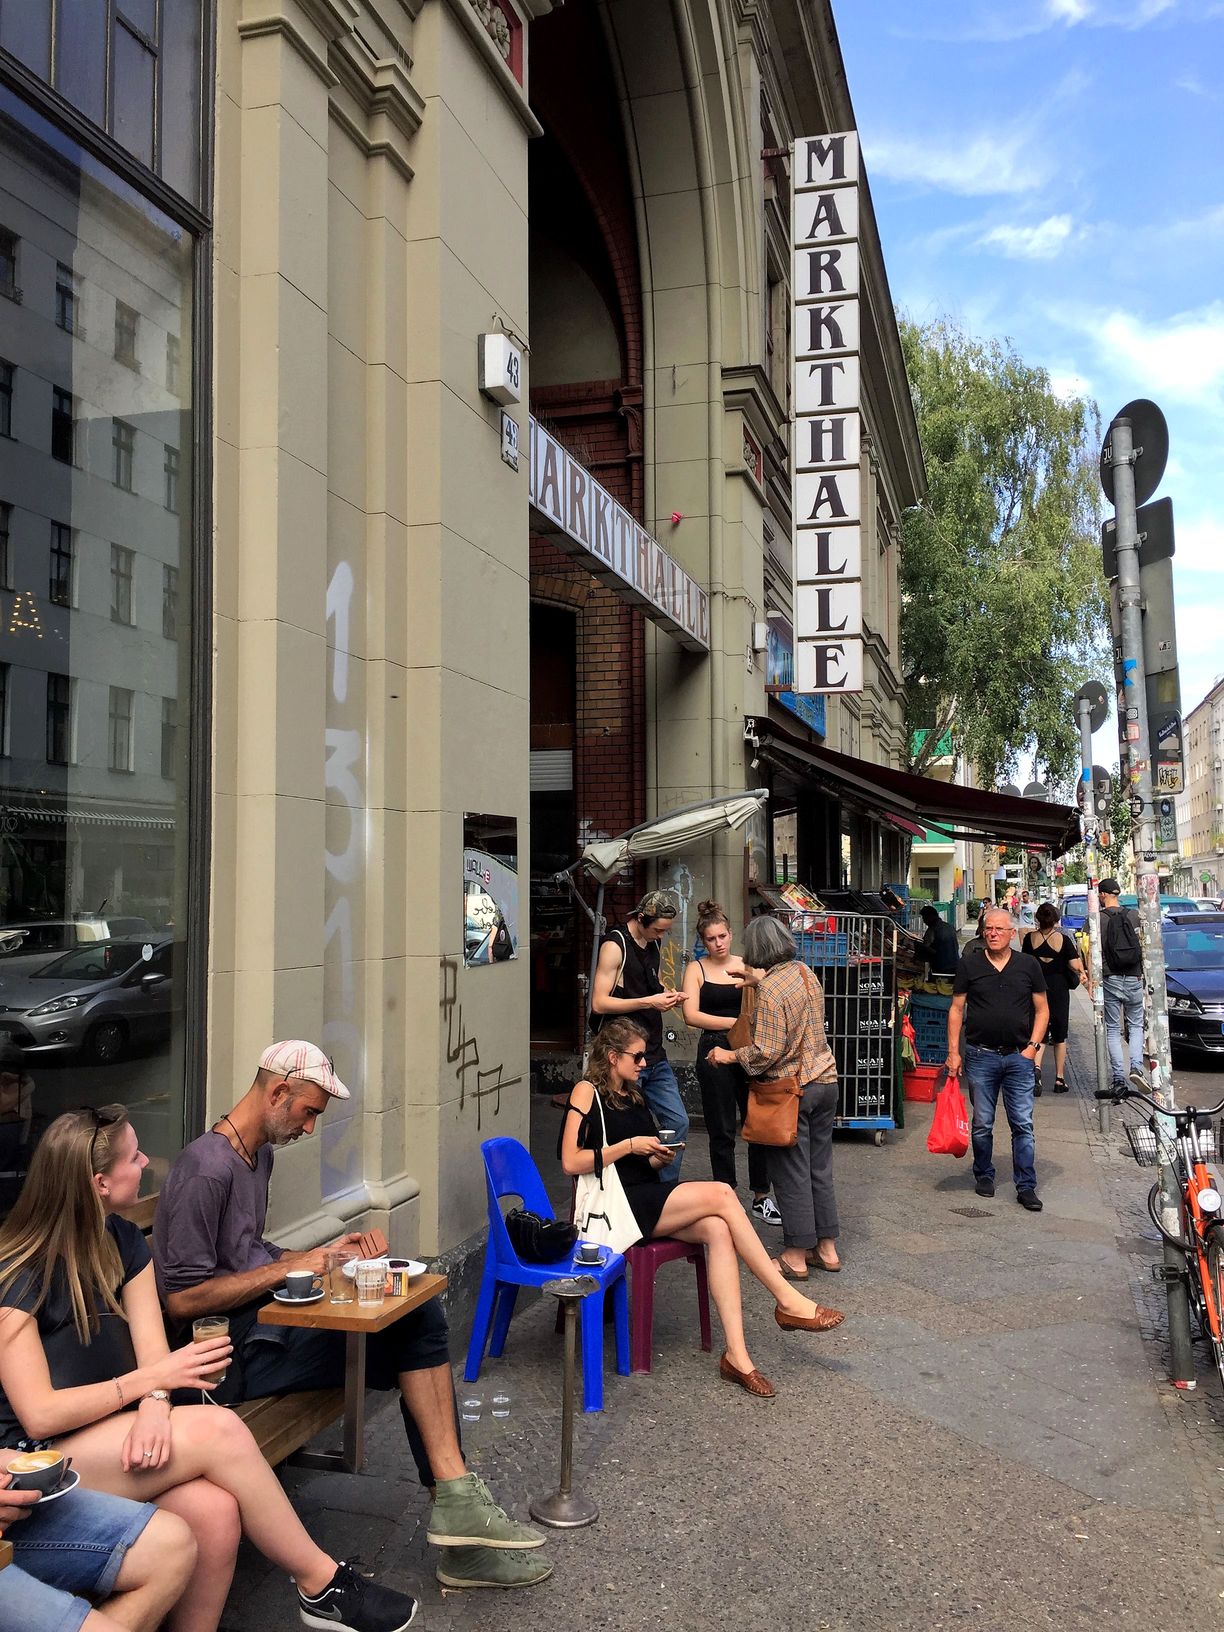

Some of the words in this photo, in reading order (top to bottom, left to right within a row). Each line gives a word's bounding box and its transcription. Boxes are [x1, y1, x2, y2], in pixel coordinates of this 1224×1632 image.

[506, 351, 519, 389] 43
[805, 134, 848, 689] MARKTHALLE
[530, 422, 708, 643] ARKTHALLE
[858, 982, 885, 990] NOAM
[859, 1018, 887, 1026] NOAM
